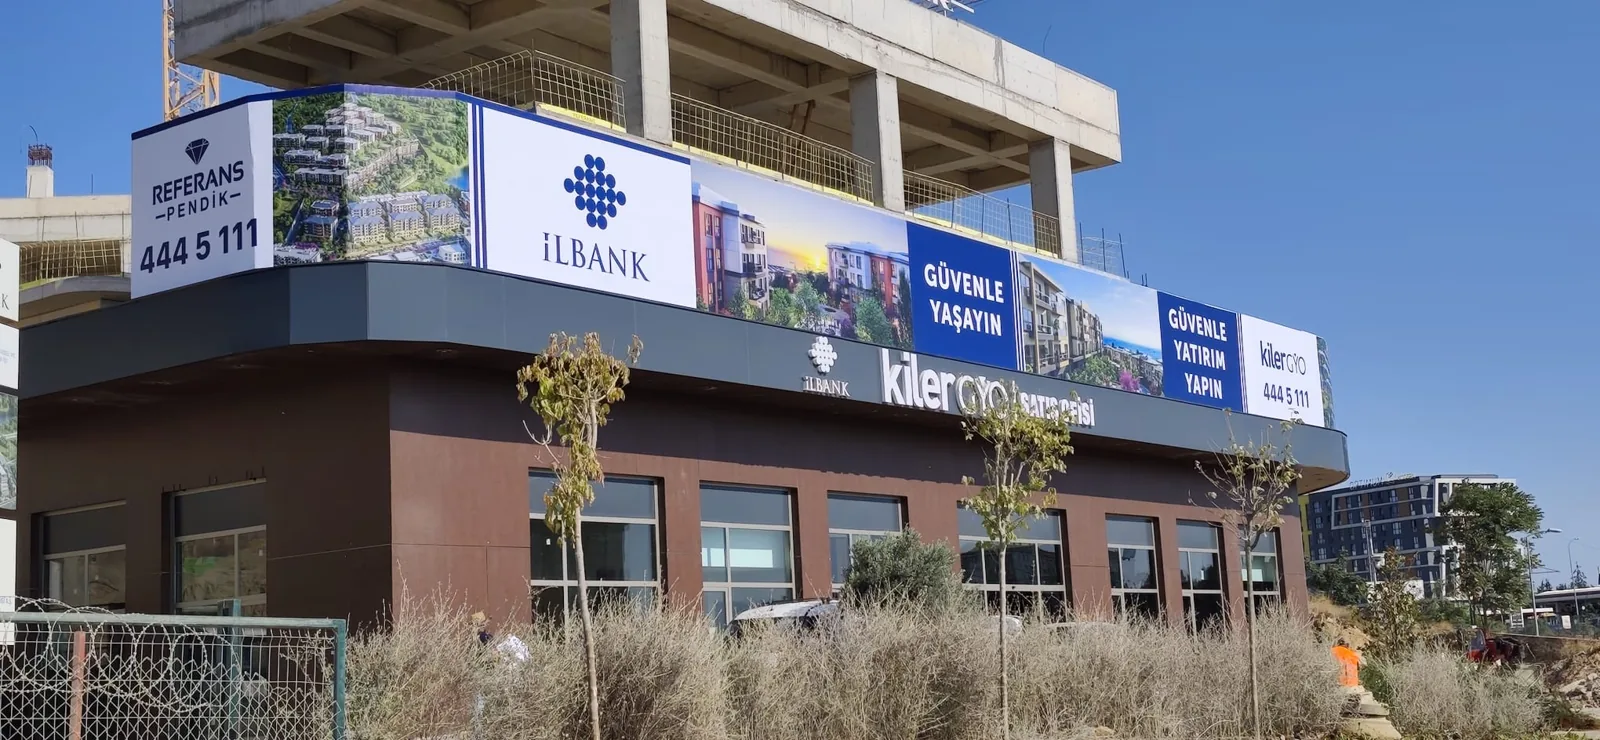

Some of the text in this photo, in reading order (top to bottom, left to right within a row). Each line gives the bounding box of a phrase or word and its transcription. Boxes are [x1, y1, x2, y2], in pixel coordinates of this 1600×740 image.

[152, 160, 244, 205] REFERANS
[166, 190, 228, 221] PENDİK
[140, 218, 258, 274] 444 5 111
[924, 260, 1005, 304] GÜVENLE
[929, 298, 1002, 337] YAŞAYIN
[1168, 305, 1228, 342] GÜVENLE
[1173, 339, 1227, 371] YATIRIM
[1184, 372, 1223, 400] YAPIN
[1263, 382, 1310, 409] 444 5 111
